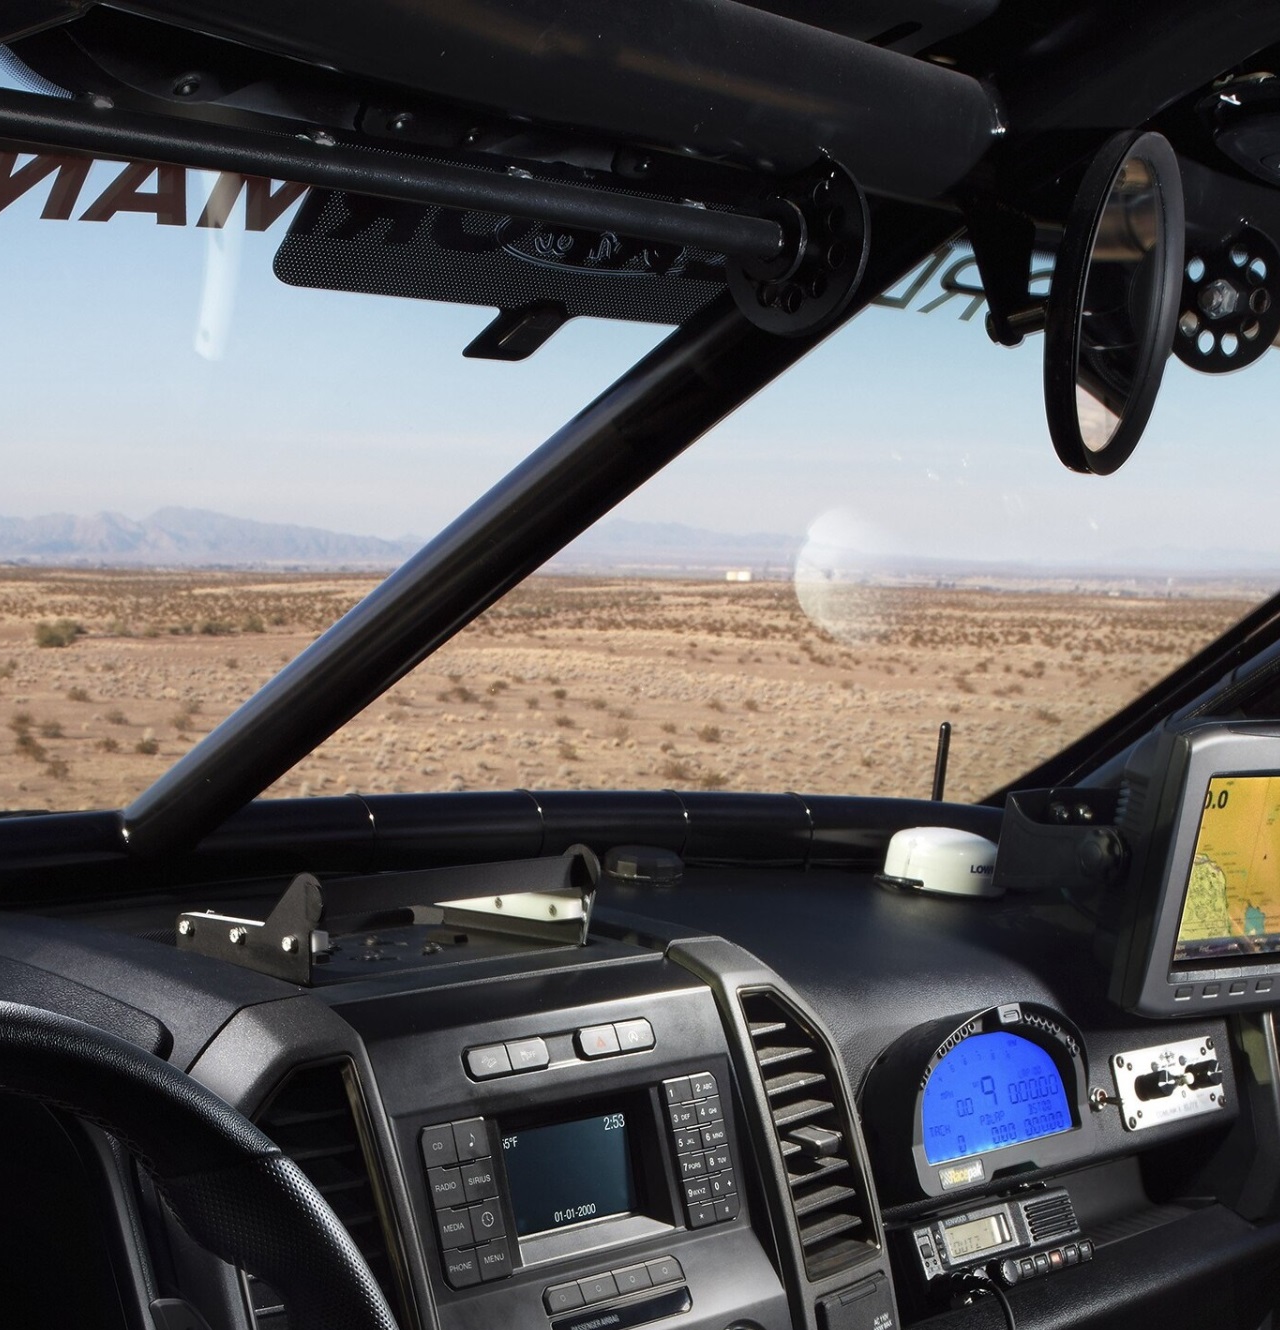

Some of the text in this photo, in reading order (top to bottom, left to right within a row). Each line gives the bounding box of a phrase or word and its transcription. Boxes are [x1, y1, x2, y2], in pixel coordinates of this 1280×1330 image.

[695, 1082, 713, 1092] 2 ABC
[669, 1089, 674, 1097] 1
[700, 1107, 718, 1116] 4 GHI
[603, 1113, 626, 1131] 2:53
[673, 1113, 691, 1122] 3 DEF
[705, 1131, 724, 1141] 6 MNO
[432, 1142, 443, 1151] CD
[678, 1138, 684, 1147] 5
[709, 1157, 715, 1166] 8
[683, 1163, 689, 1171] 7
[468, 1174, 491, 1186] SIRIUS
[435, 1181, 457, 1192] RADIO
[714, 1181, 720, 1190] 0
[688, 1188, 693, 1197] 9
[554, 1203, 596, 1223] 01-01-2000
[945, 1214, 967, 1226] KENWOOD
[443, 1222, 465, 1233] MEDIA
[484, 1253, 505, 1264] MENU
[449, 1261, 472, 1273] PHONE
[600, 1314, 620, 1326] AIRBAG
